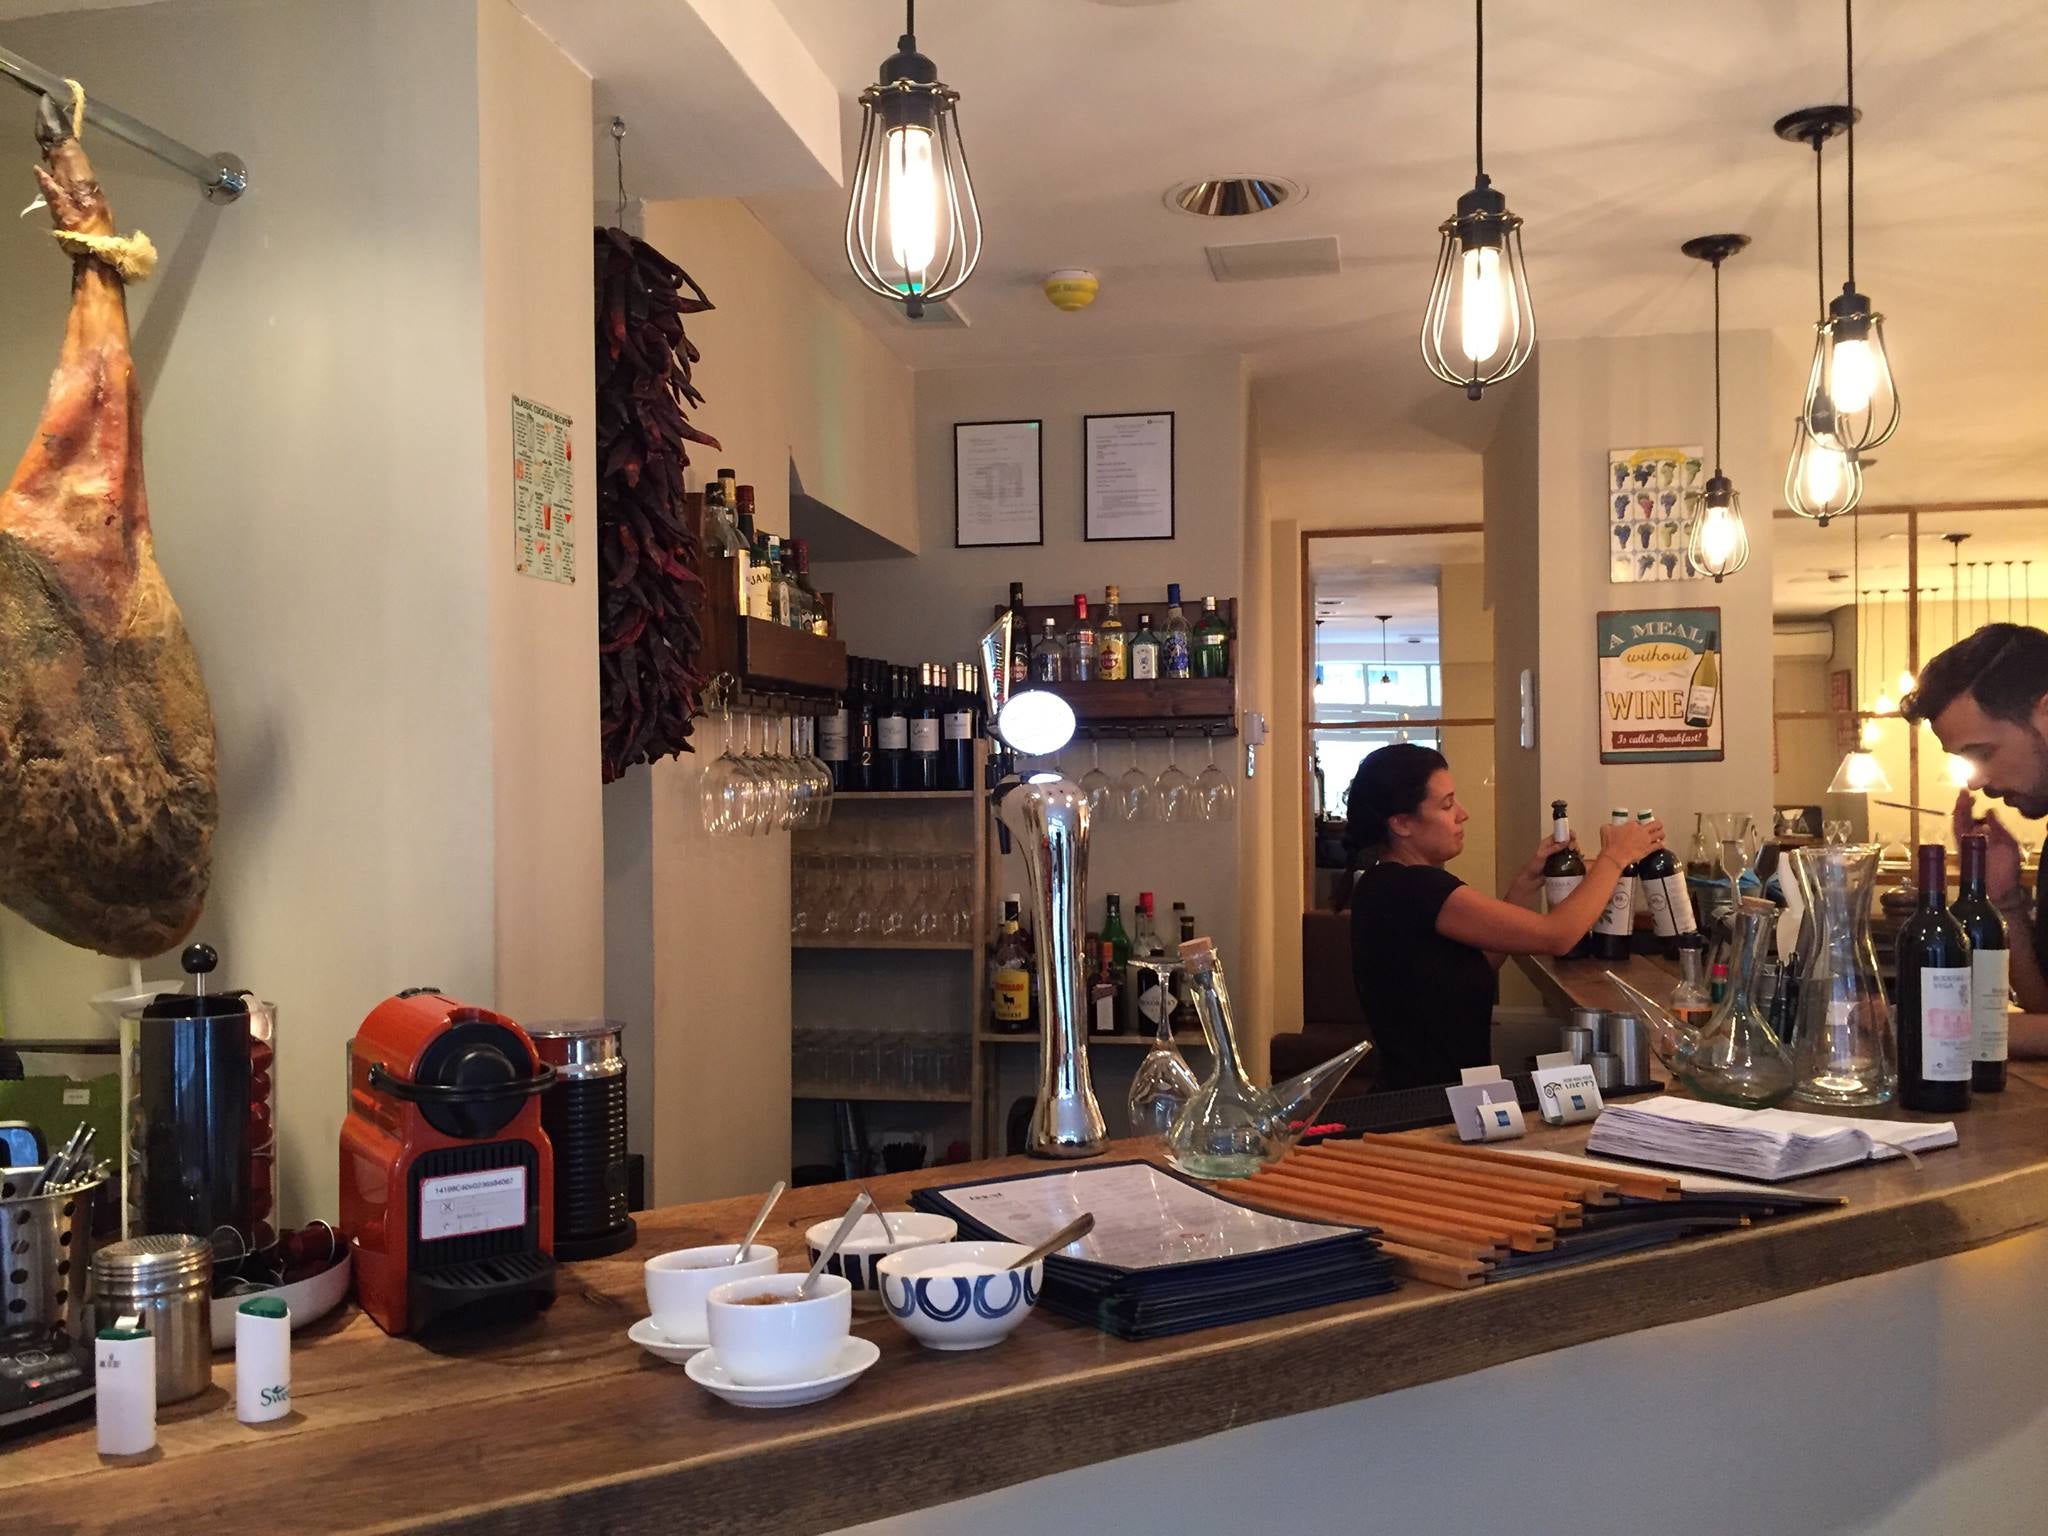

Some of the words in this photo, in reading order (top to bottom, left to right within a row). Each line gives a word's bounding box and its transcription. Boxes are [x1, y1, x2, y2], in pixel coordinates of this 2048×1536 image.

[1609, 633, 1625, 650] A
[1631, 621, 1705, 645] MEAL
[1626, 645, 1689, 663] without
[1605, 690, 1684, 720] WINE
[1617, 735, 1628, 745] Is
[1629, 733, 1655, 745] called
[1656, 732, 1703, 745] Breakfast!
[862, 751, 872, 766] 2
